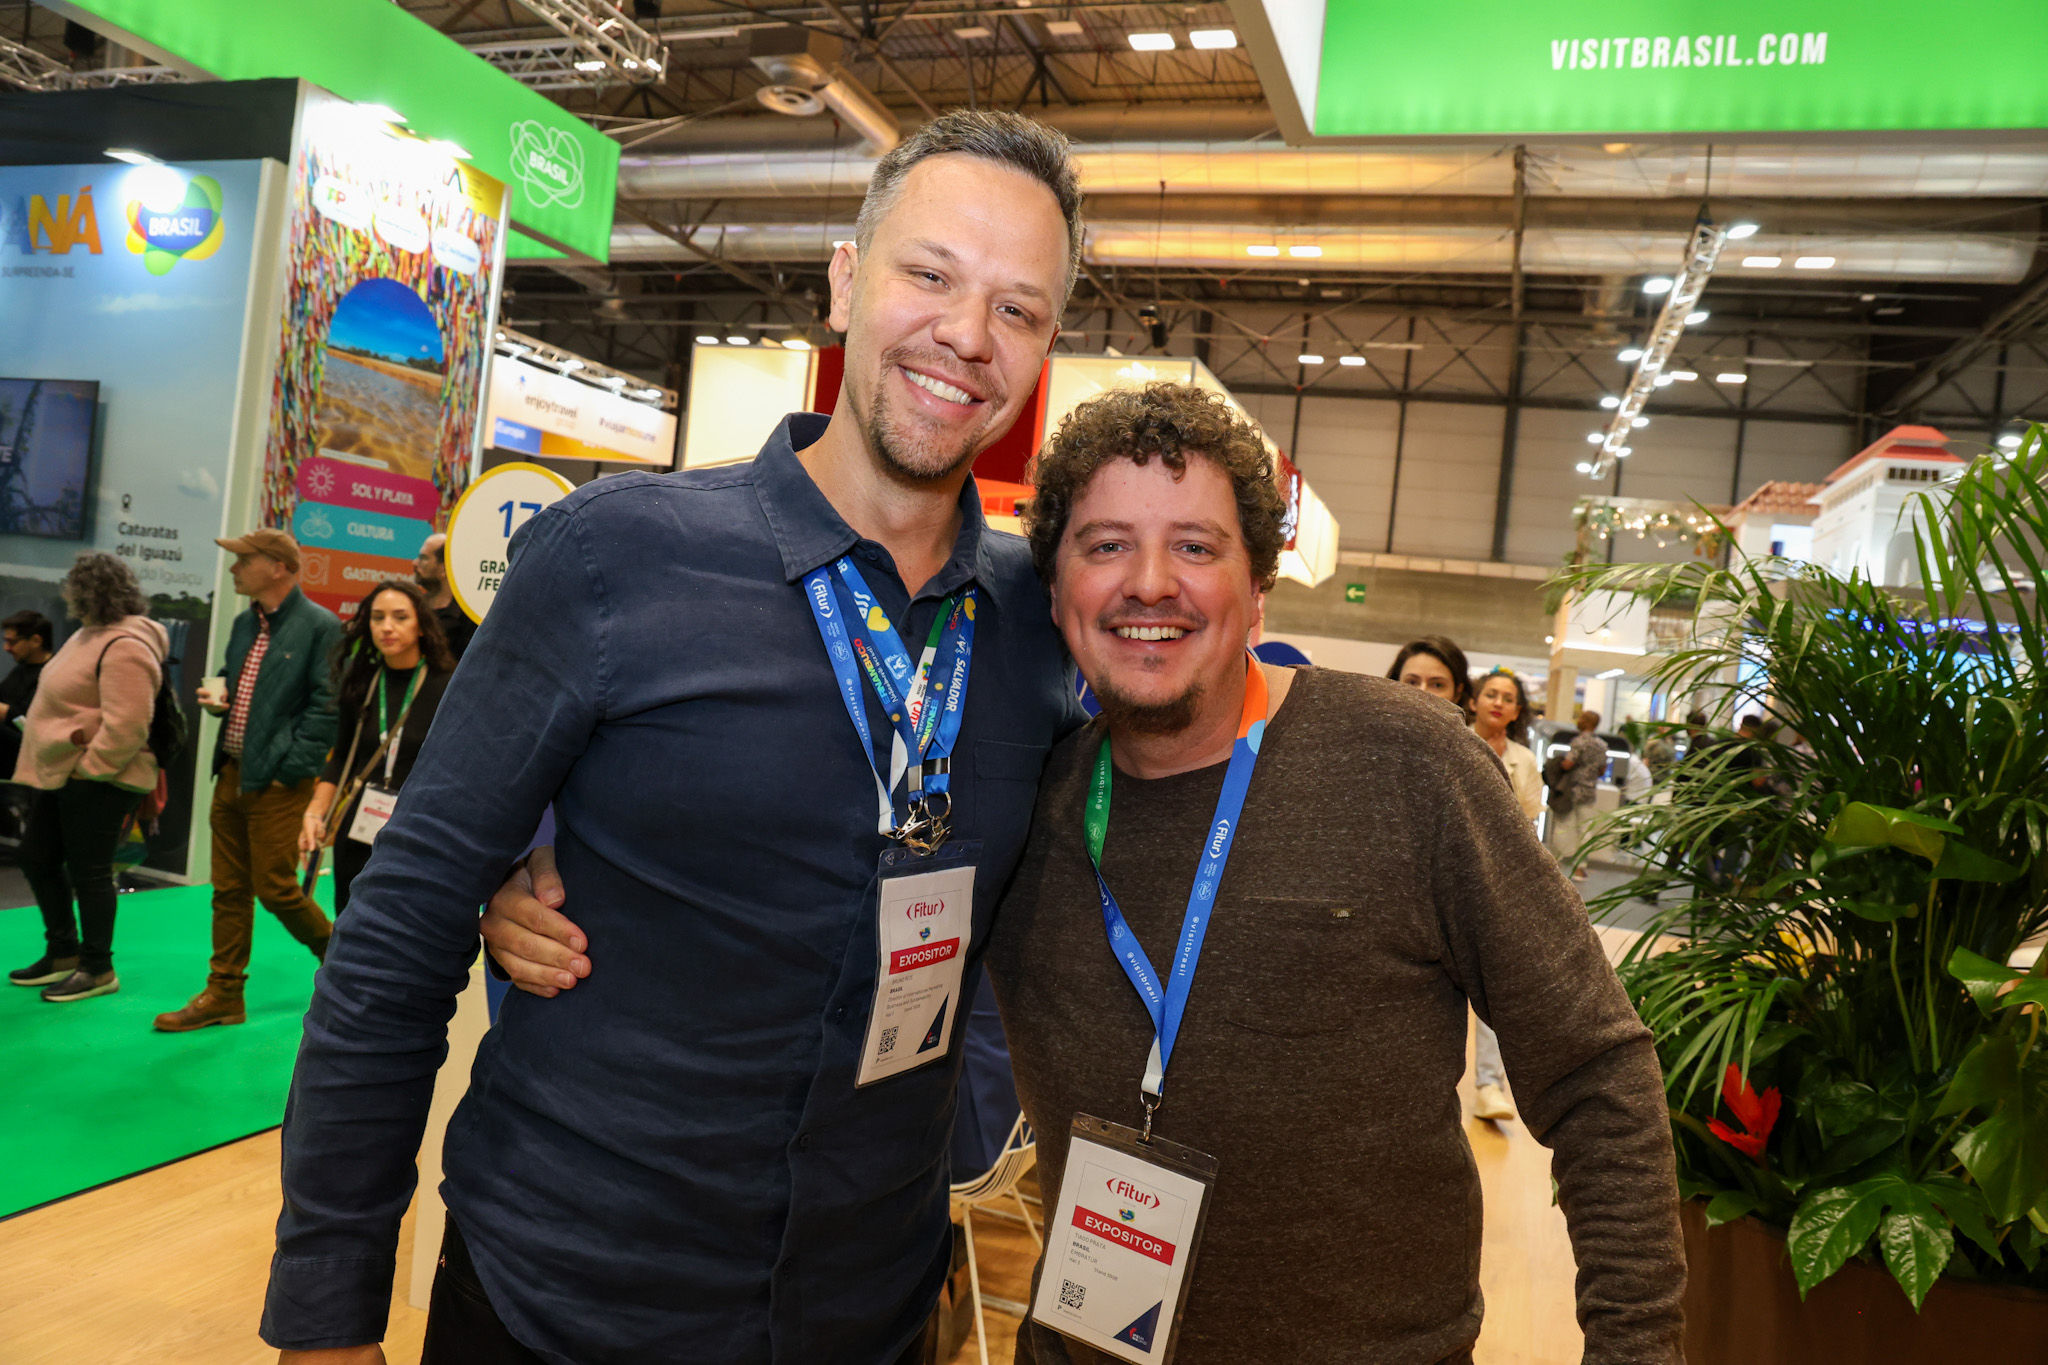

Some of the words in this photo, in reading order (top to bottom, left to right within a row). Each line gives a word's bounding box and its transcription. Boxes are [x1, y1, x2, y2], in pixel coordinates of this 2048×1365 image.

[1550, 31, 1828, 71] VISITBRASIL.COM
[529, 150, 570, 187] BRASIL
[0, 184, 104, 255] ANÁ
[148, 216, 204, 237] BRASIL
[351, 482, 372, 499] SOL
[374, 487, 382, 500] Y
[382, 490, 415, 506] PLAYA
[117, 521, 179, 541] Cataratas
[346, 522, 395, 541] CULTURA
[116, 542, 137, 557] del
[945, 657, 967, 713] SALVADOR
[899, 944, 953, 968] EXPOSITOR
[1178, 915, 1200, 977] @visitbrasil
[1127, 951, 1160, 1003] @visitbrasil
[1072, 1241, 1091, 1253] BRASIL
[1084, 1215, 1163, 1256] EXPOSITOR
[1089, 1237, 1107, 1250] PRATA
[1070, 1250, 1098, 1264] EMBRATUR
